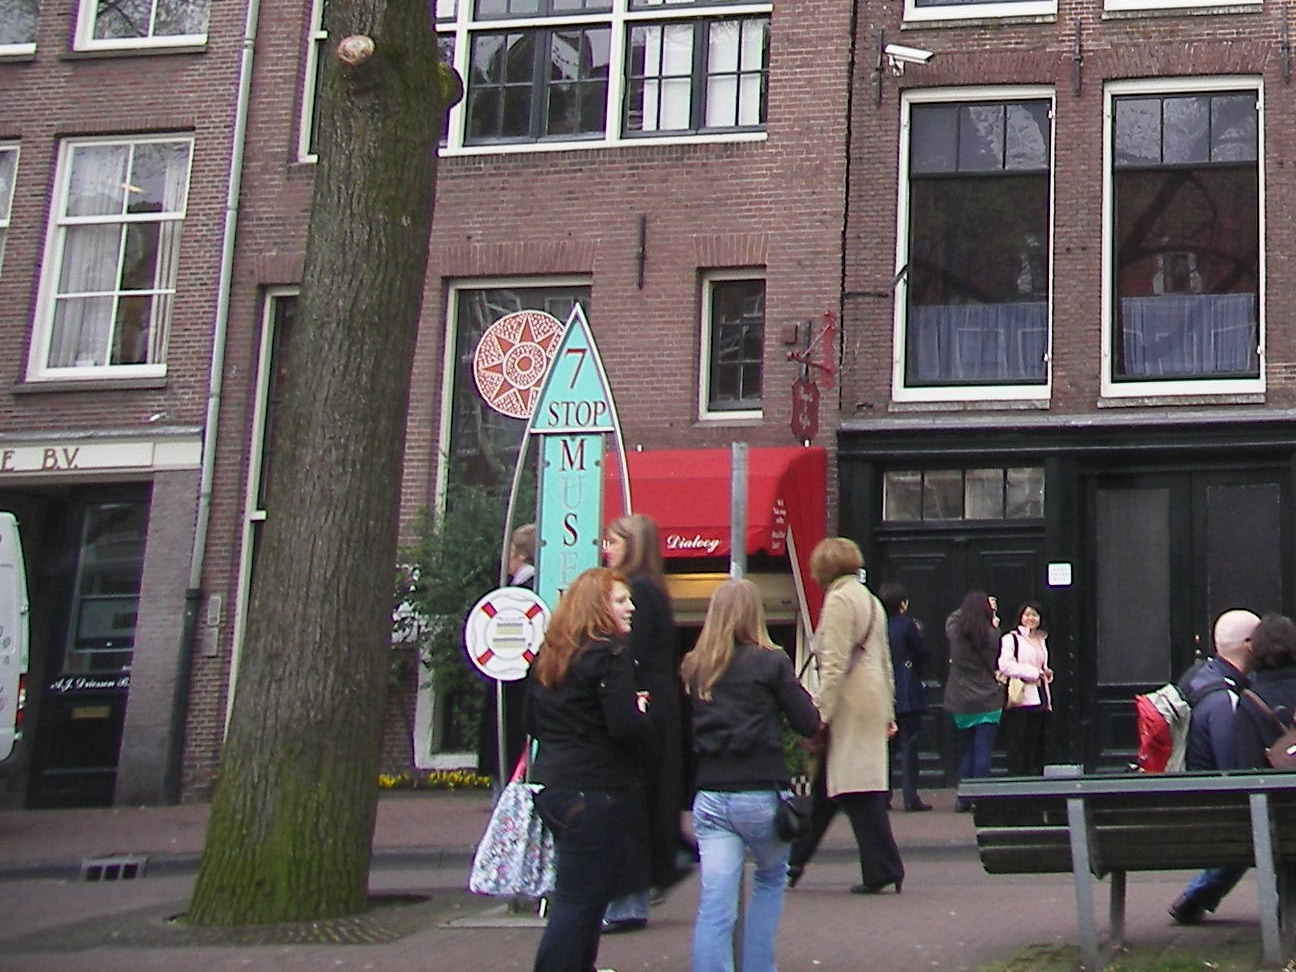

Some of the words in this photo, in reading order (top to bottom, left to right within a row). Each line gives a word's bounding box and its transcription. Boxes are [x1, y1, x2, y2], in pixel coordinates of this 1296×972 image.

[564, 348, 587, 389] 7
[547, 400, 606, 427] STOP
[41, 447, 80, 470] B.V.
[557, 437, 587, 604] MUSE
